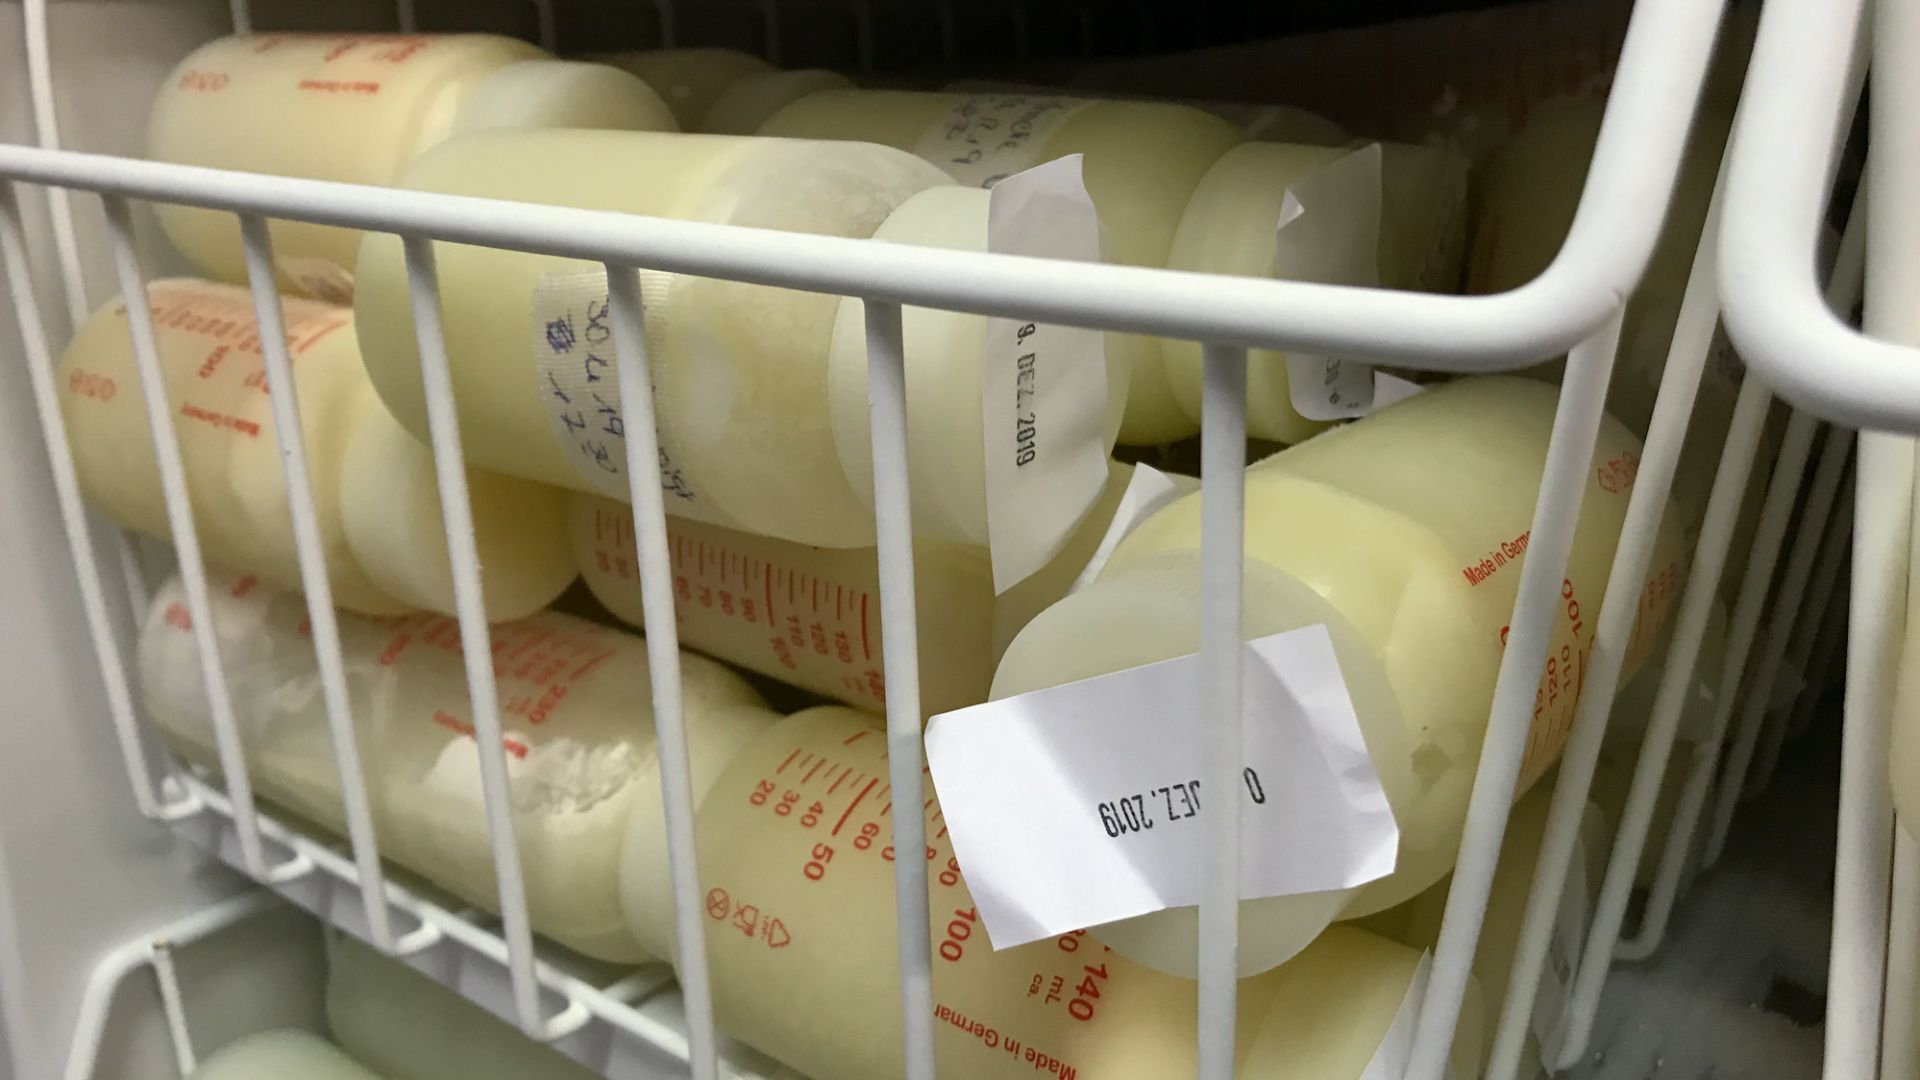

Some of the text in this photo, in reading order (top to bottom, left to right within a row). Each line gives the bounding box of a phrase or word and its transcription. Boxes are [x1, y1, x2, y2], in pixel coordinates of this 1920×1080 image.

[1016, 412, 1036, 467] 2019
[1463, 558, 1497, 587] Made
[1494, 551, 1508, 568] in
[1560, 577, 1584, 640] 100
[1546, 656, 1559, 708] 120
[1561, 644, 1573, 693] 110
[749, 779, 776, 806] 20
[774, 789, 801, 817] 30
[799, 800, 824, 829] 40
[1097, 794, 1154, 838] 2019
[853, 821, 881, 851] 60
[803, 841, 835, 881] 50
[938, 907, 976, 962] 100
[1026, 974, 1043, 998] ca.
[1044, 975, 1064, 1005] mL
[1067, 962, 1109, 1022] 140
[1003, 1035, 1021, 1060] in
[1024, 1046, 1077, 1080] Made
